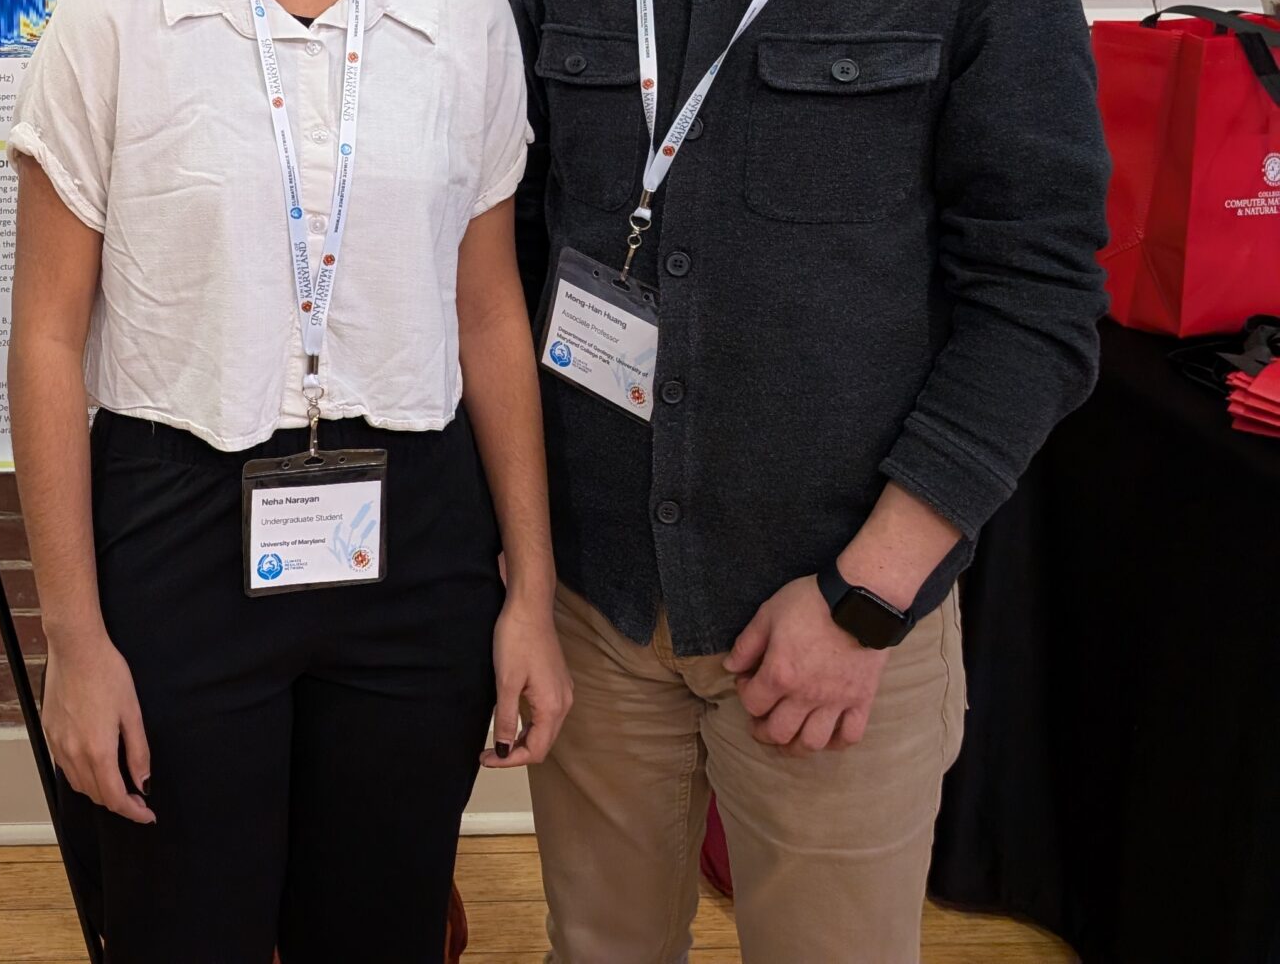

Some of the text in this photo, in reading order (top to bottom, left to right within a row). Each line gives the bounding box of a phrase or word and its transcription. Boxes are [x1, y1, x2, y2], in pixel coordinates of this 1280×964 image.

[264, 38, 282, 94] MARYLAND
[343, 65, 353, 122] MARYLAND
[672, 94, 702, 146] MARYLAND
[299, 241, 313, 298] MARYLAND
[310, 268, 328, 326] MARYLAND
[565, 291, 627, 330] Mong-Han Huang
[562, 309, 620, 344] Associate Professor
[261, 513, 343, 526] Undergraduate Student
[262, 496, 320, 506] Neha Narayan
